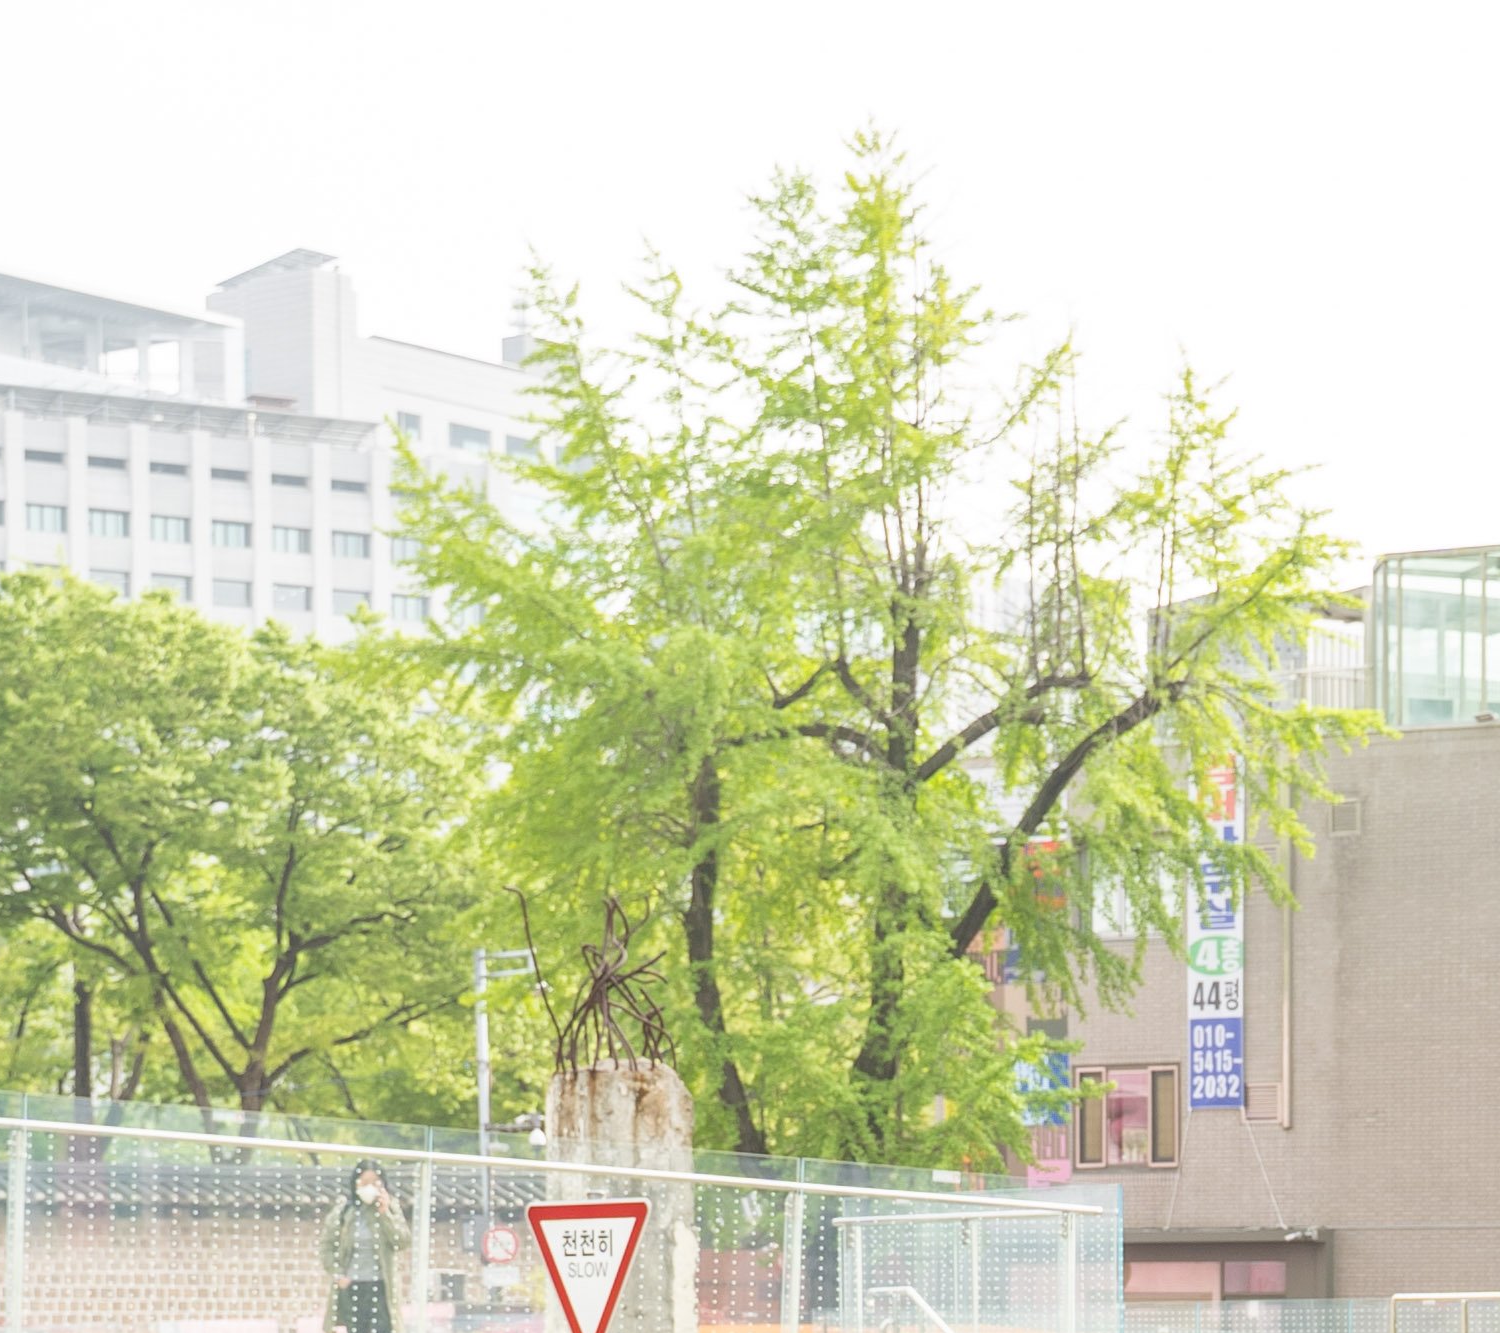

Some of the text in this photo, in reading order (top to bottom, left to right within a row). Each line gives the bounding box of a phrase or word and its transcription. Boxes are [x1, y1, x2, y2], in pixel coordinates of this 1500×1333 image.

[1193, 1024, 1235, 1048] 010-
[1193, 1051, 1243, 1073] 5415-
[1192, 1074, 1240, 1099] 2032
[562, 1229, 613, 1257] 천천히
[567, 1261, 609, 1279] SLOW
